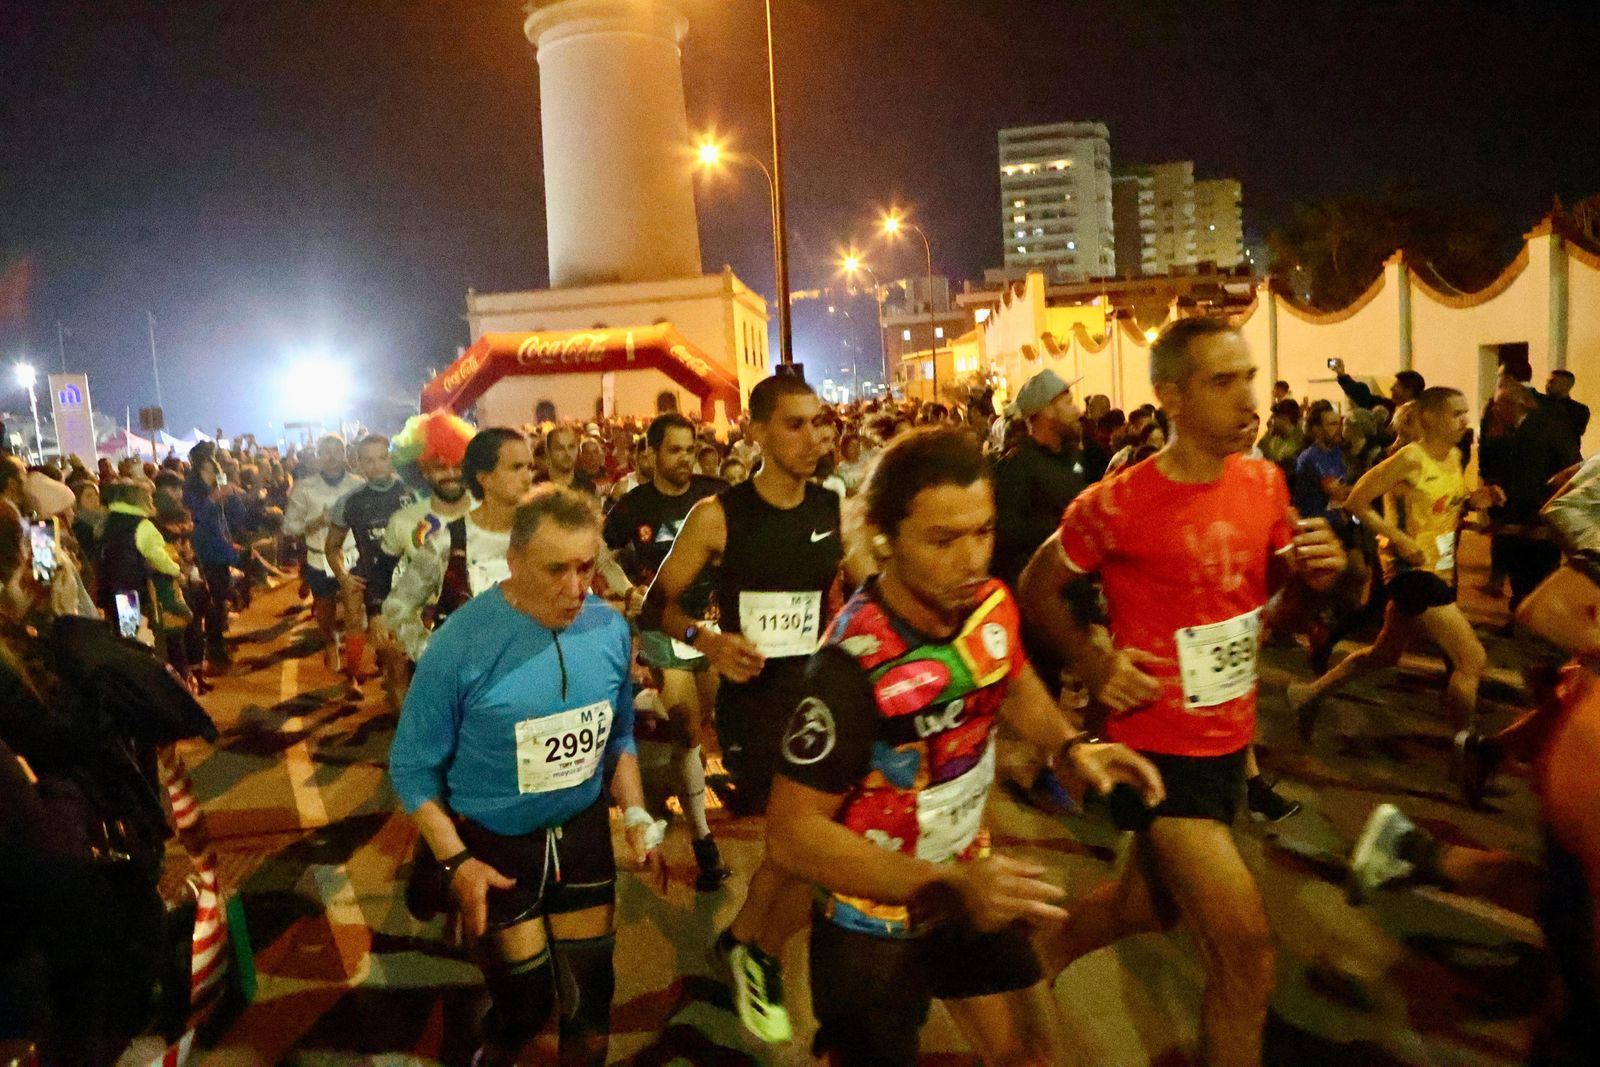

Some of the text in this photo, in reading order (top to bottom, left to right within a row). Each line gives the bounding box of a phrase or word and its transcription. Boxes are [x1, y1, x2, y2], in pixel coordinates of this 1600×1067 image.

[759, 613, 802, 632] 1130
[581, 710, 593, 723] M
[544, 728, 594, 763] 299
